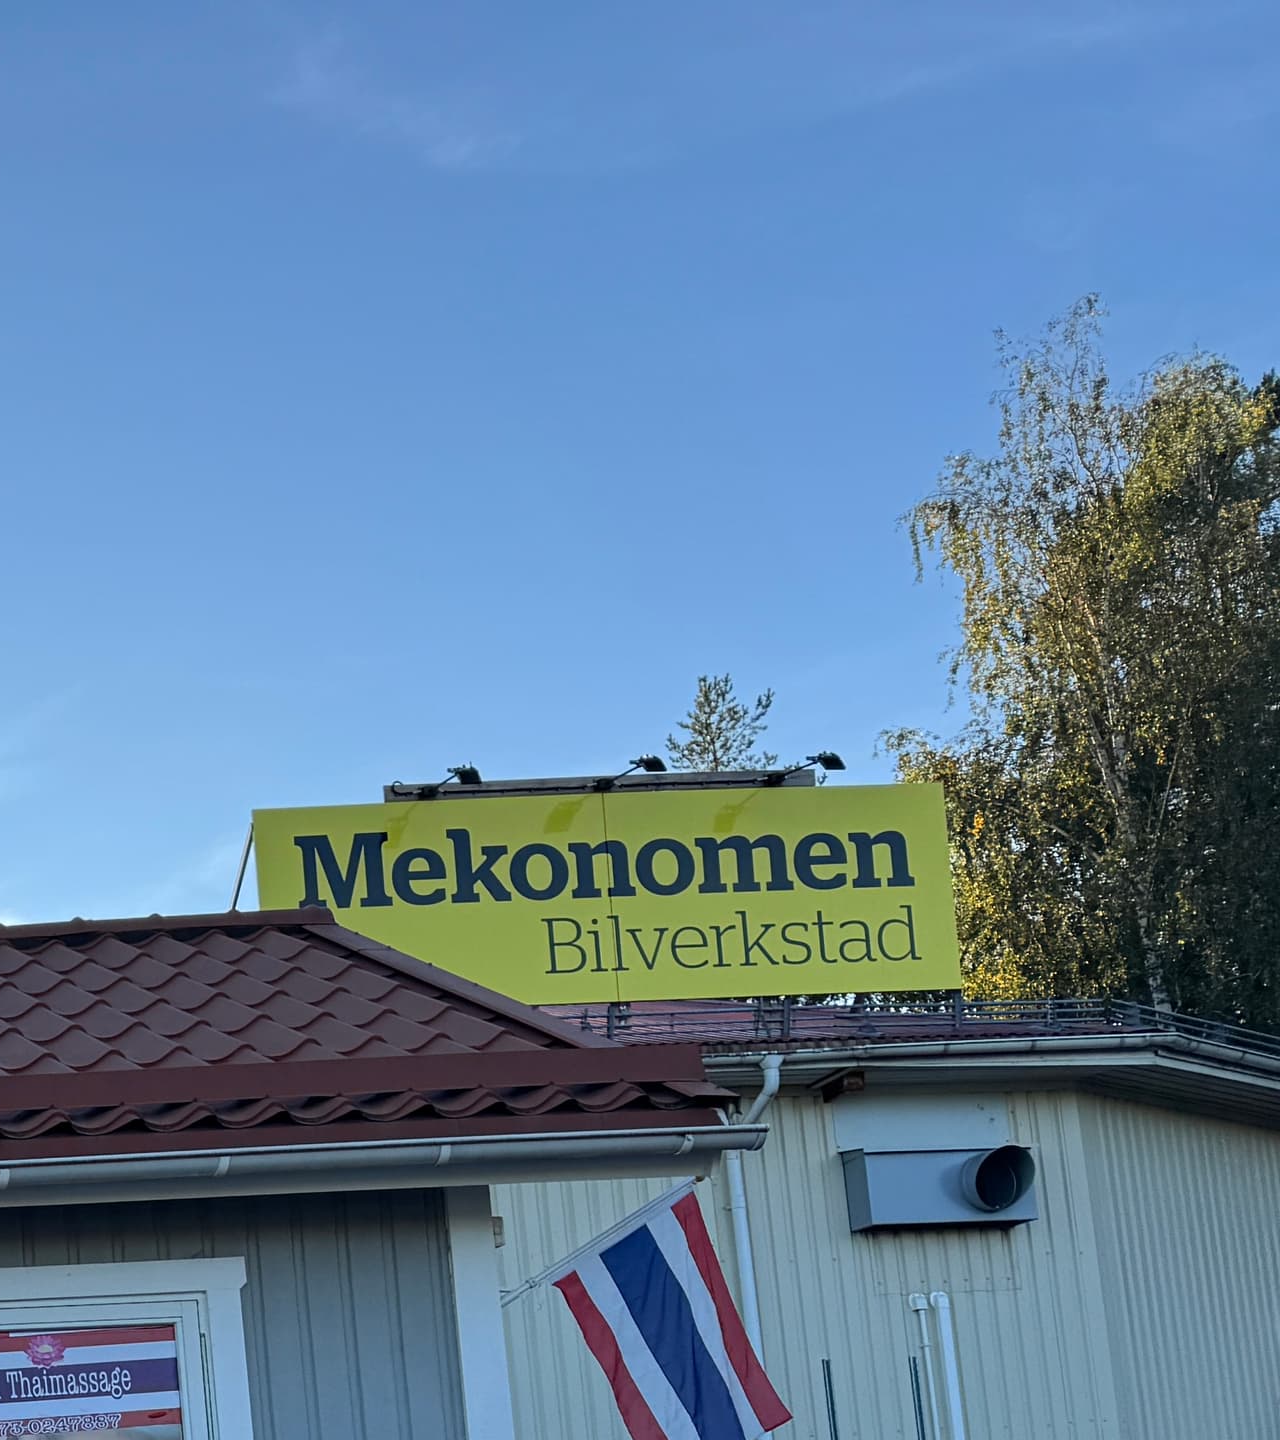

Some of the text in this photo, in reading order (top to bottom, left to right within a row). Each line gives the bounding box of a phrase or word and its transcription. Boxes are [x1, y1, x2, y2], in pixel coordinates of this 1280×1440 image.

[293, 828, 915, 909] Mekonomen
[541, 905, 922, 975] Bilverkstad
[6, 1366, 132, 1398] Thaimassage
